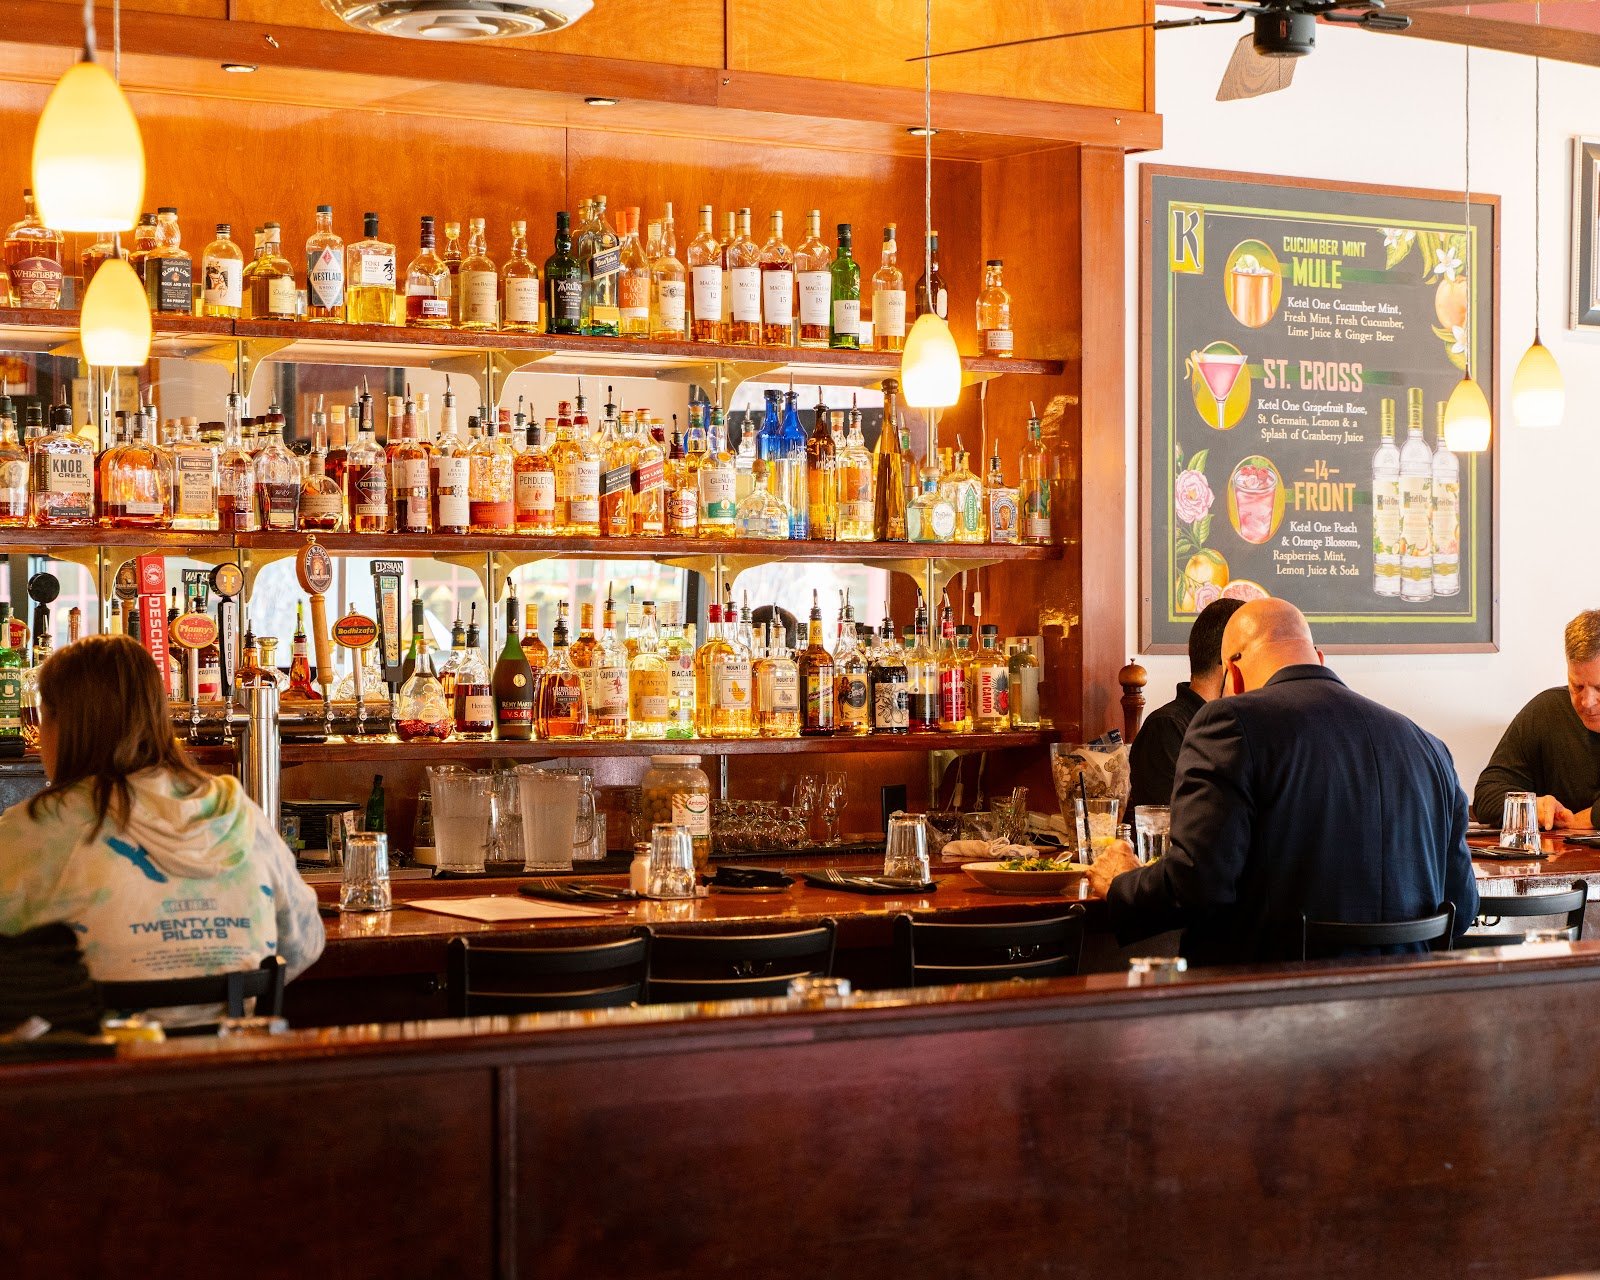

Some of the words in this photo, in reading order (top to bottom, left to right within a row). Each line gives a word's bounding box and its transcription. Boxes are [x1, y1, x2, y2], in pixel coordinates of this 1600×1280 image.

[1283, 236, 1338, 255] CUCUMBER
[1342, 240, 1366, 257] MINT
[312, 272, 342, 282] WESTLAND
[1292, 257, 1342, 289] MULE
[1287, 297, 1309, 308] Ketel
[1312, 299, 1331, 310] One
[1333, 299, 1376, 313] Cucumber
[1378, 303, 1402, 315] Mint,
[1284, 311, 1307, 323] Fresh
[1309, 312, 1332, 325] Mint,
[1335, 315, 1358, 326] Fresh
[1361, 316, 1404, 329] Cucumber,
[1288, 326, 1309, 336] Lime
[1310, 327, 1332, 340] Juice
[1334, 329, 1342, 339] &
[1345, 329, 1374, 343] Ginger
[1376, 331, 1395, 342] Beer
[1263, 358, 1291, 389] ST.
[1299, 360, 1363, 392] CROSS
[1258, 399, 1279, 410] Ketel
[1281, 400, 1300, 411] One
[1302, 401, 1344, 415] Grapefruit
[1346, 403, 1368, 415] Rose,
[1258, 413, 1268, 424] St.
[1312, 415, 1340, 427] Lemon
[1342, 417, 1350, 427] &
[1261, 428, 1287, 443] Splash
[1290, 429, 1300, 440] of
[1301, 429, 1342, 445] Cranberry
[1343, 431, 1364, 445] Juice
[53, 459, 82, 473] KNOB
[86, 479, 91, 488] 9
[1293, 481, 1356, 512] FRONT
[1289, 521, 1311, 532] Ketel
[1313, 522, 1332, 533] One
[1334, 522, 1358, 533] Peach
[1281, 536, 1290, 547] &
[1292, 535, 1322, 550] Orange
[1325, 536, 1361, 550] Blossom,
[1273, 549, 1321, 564] Raspberries,
[1324, 550, 1346, 562] Mint,
[375, 562, 403, 573] ELYSIAN
[1276, 564, 1305, 575] Lemon
[1307, 564, 1327, 578] Juice
[1329, 565, 1337, 575] &
[1340, 565, 1359, 576] Soda
[180, 624, 213, 635] Manny's
[338, 627, 374, 635] Bodhizafa
[600, 670, 617, 679] Captain
[129, 917, 209, 935] TWENTY
